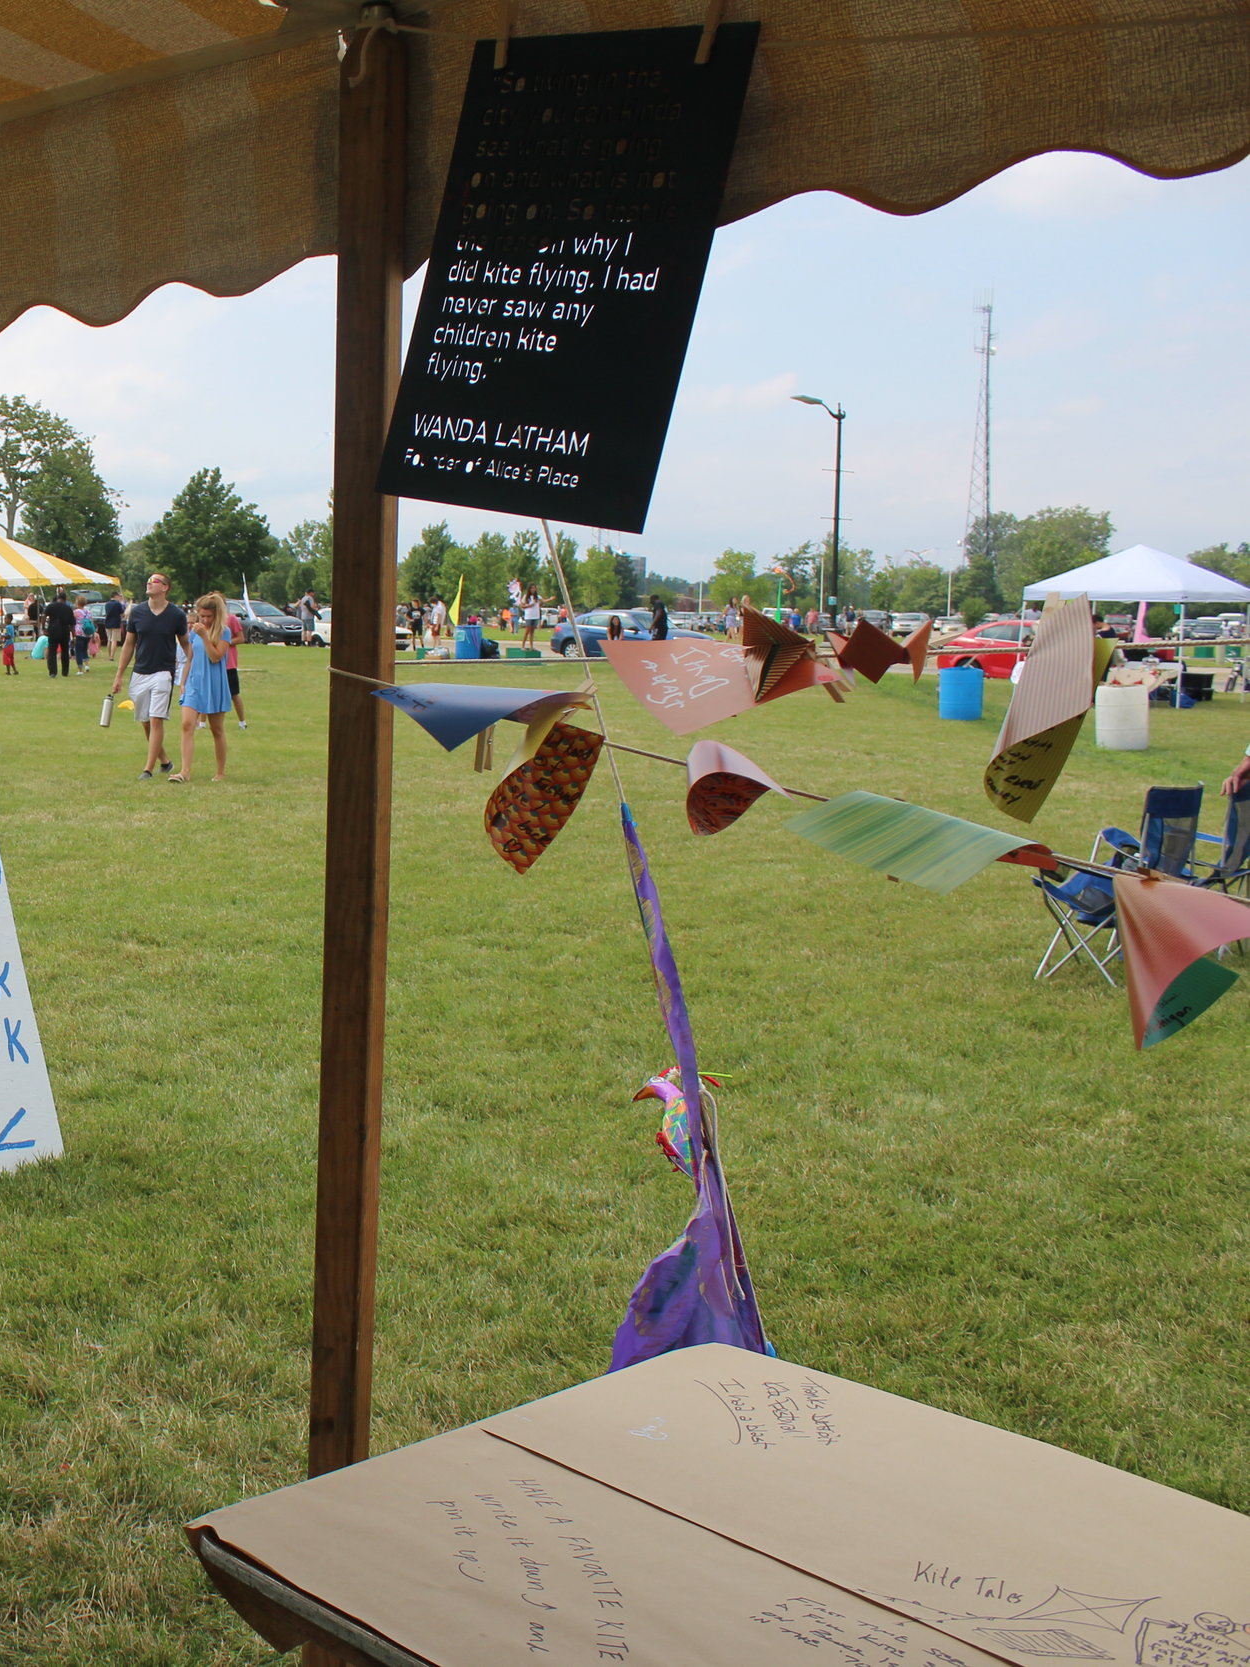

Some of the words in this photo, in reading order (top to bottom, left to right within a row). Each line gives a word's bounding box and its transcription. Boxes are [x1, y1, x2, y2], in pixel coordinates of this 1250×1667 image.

[626, 68, 662, 89] the
[476, 139, 510, 158] see
[470, 171, 494, 188] on
[574, 232, 619, 262] why
[625, 231, 633, 256] I
[448, 259, 477, 283] did
[483, 261, 522, 285] kite
[528, 262, 594, 294] flying.
[603, 265, 612, 289] I
[616, 266, 660, 292] had
[442, 296, 498, 316] never
[502, 299, 546, 319] saw
[552, 302, 595, 327] any
[433, 322, 511, 349] children
[517, 327, 558, 352] kite
[414, 413, 487, 444] WANDA
[494, 422, 591, 457] LATHAM
[404, 448, 461, 471] Foder
[485, 459, 533, 482] Alice's
[537, 465, 580, 488] Place
[718, 1378, 745, 1393] I
[509, 1479, 563, 1507] HAVE
[425, 1500, 463, 1521] pin
[474, 1493, 518, 1529] write
[545, 1516, 574, 1524] A
[454, 1526, 478, 1538] it
[506, 1537, 534, 1548] it
[453, 1549, 478, 1562] up
[519, 1556, 549, 1591] down
[558, 1536, 624, 1608] FAVORITE
[914, 1561, 961, 1590] Kite
[974, 1576, 1024, 1604] Tales
[526, 1621, 550, 1653] and
[594, 1619, 629, 1661] KITE
